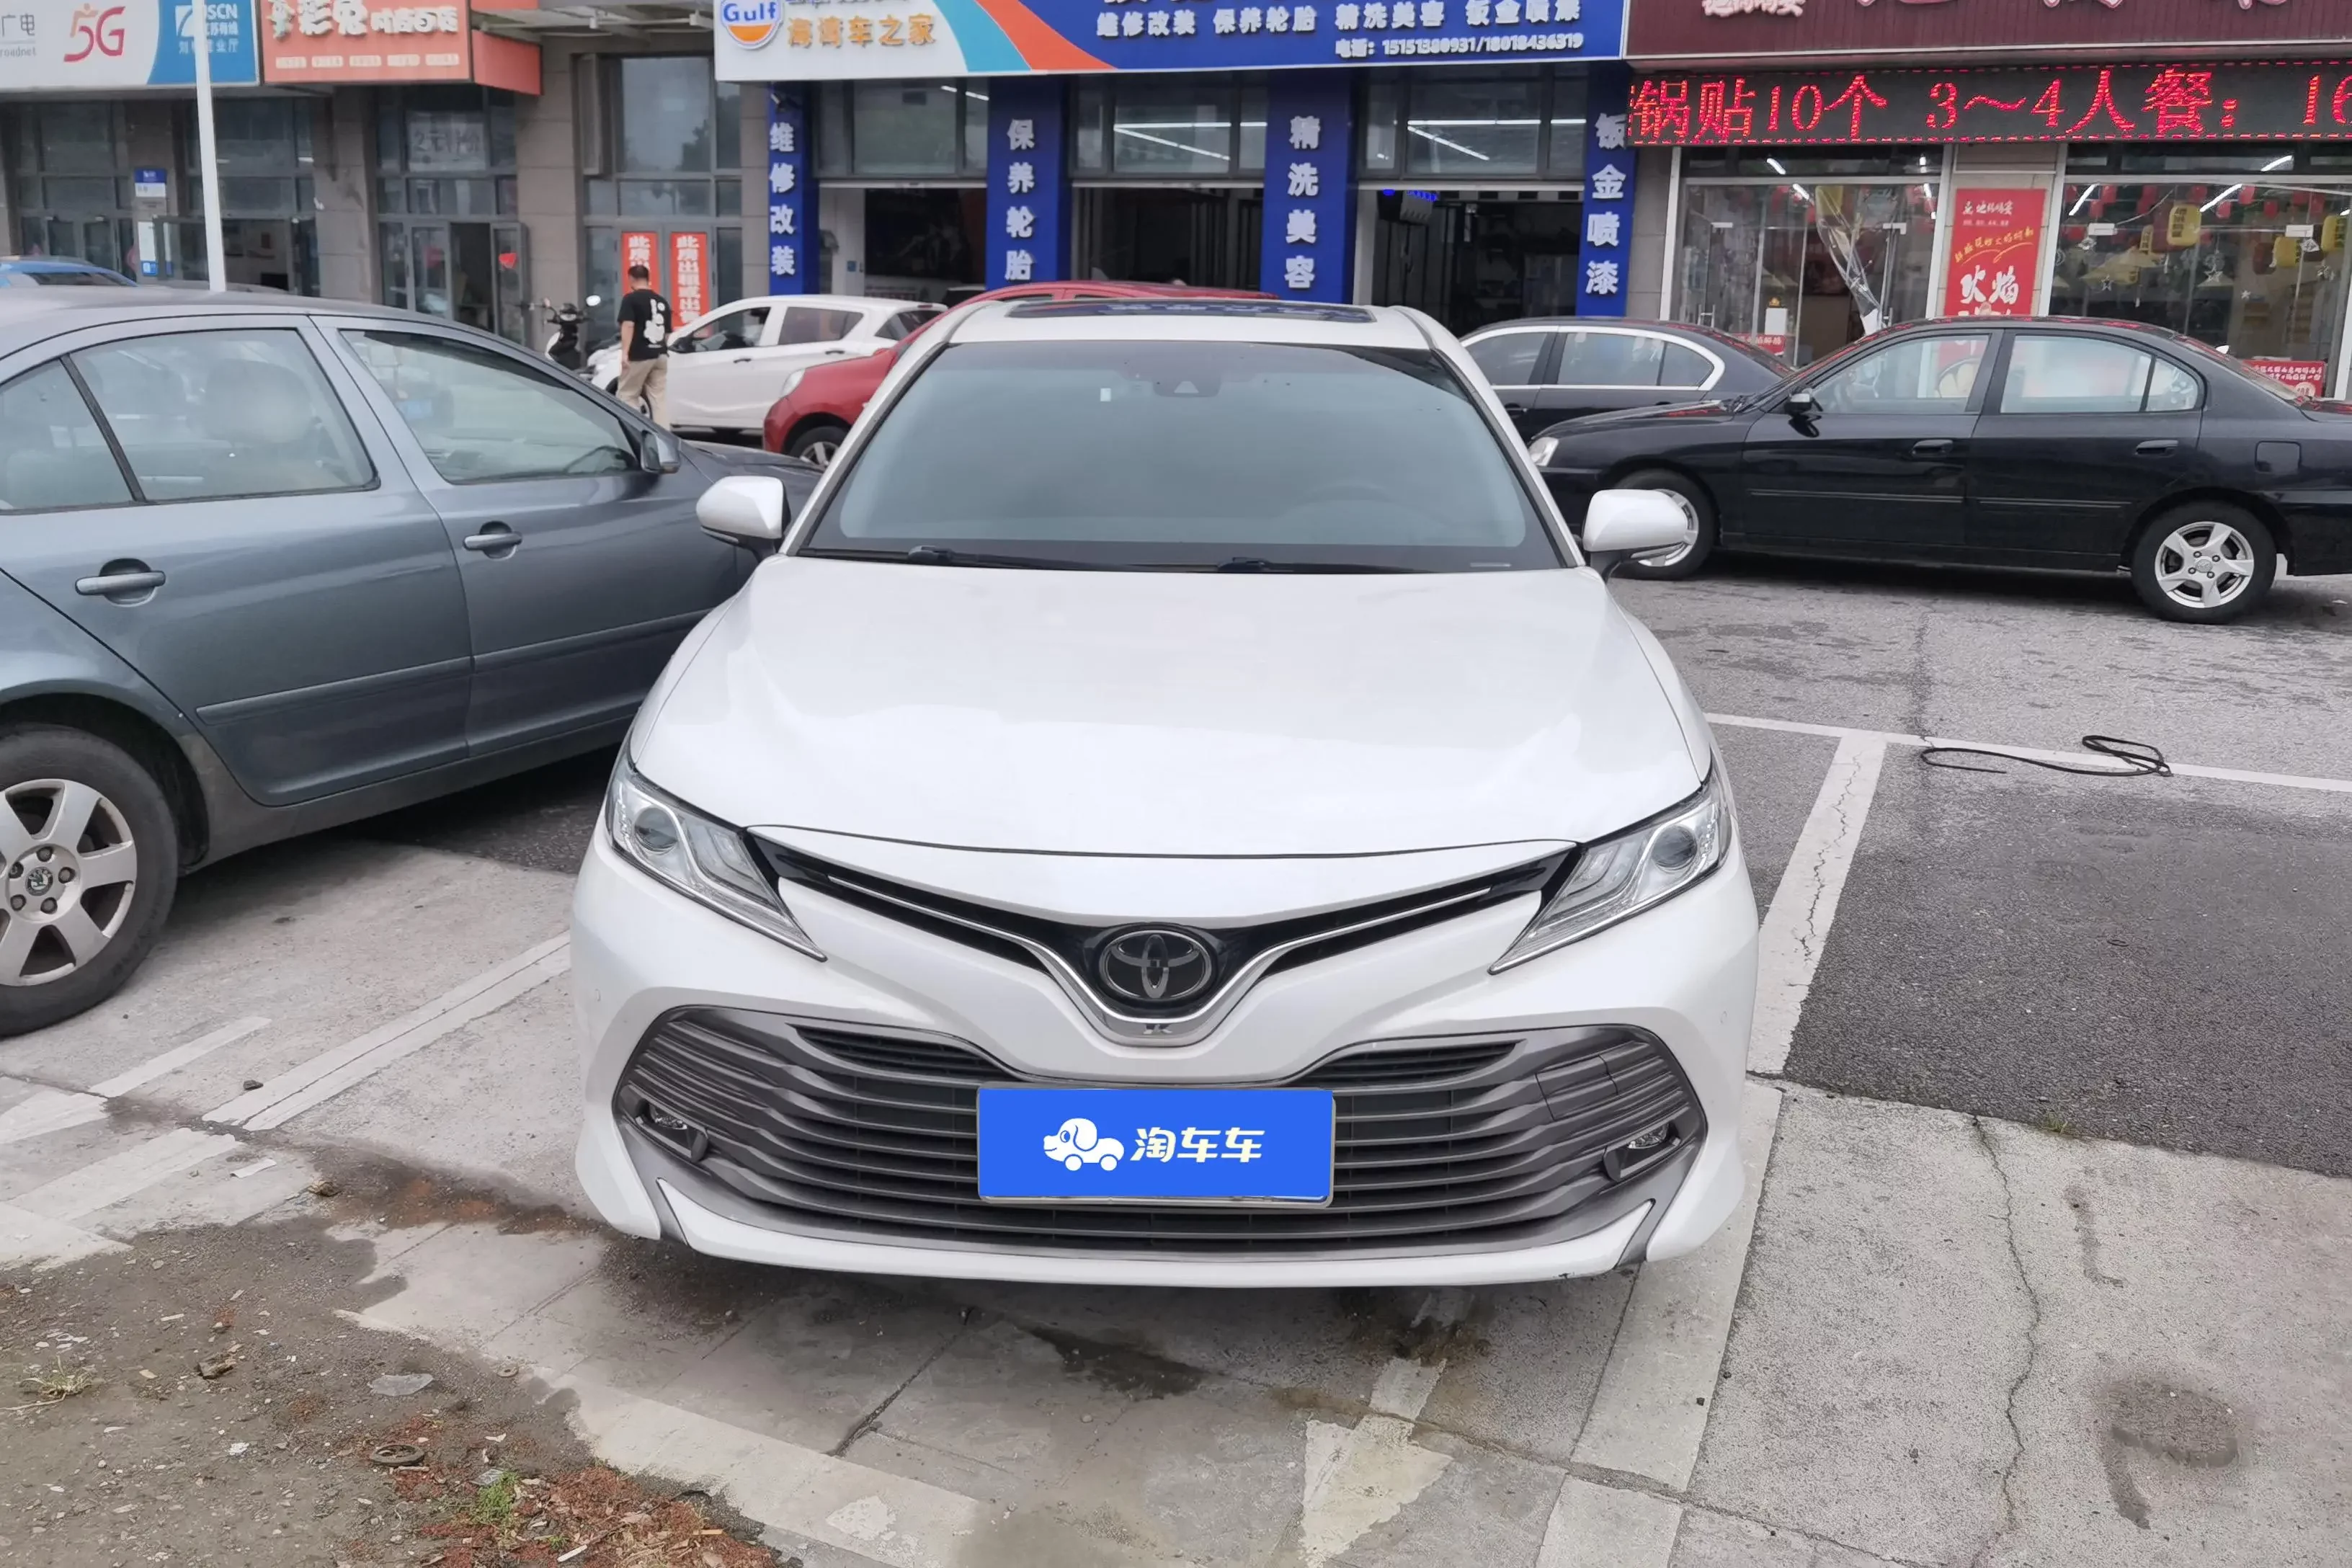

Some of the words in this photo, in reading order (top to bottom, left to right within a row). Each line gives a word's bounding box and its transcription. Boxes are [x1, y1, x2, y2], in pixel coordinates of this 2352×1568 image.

[1, 13, 35, 37] 广电
[63, 2, 126, 62] 5G
[204, 4, 238, 19] SCN
[206, 21, 239, 36] 苏有线
[723, 2, 776, 22] Gulf
[1097, 9, 1195, 36] 维修改装
[1213, 5, 1317, 34] 保养轮胎
[1335, 1, 1445, 30] 精洗美容
[1627, 74, 1889, 140] 锅贴10个
[770, 122, 796, 276] 维修改装
[1004, 119, 1036, 280] 保养轮胎
[1284, 115, 1321, 288] 精洗美容
[1585, 112, 1626, 295] 钣金喷漆
[1959, 264, 2019, 305] 火焰
